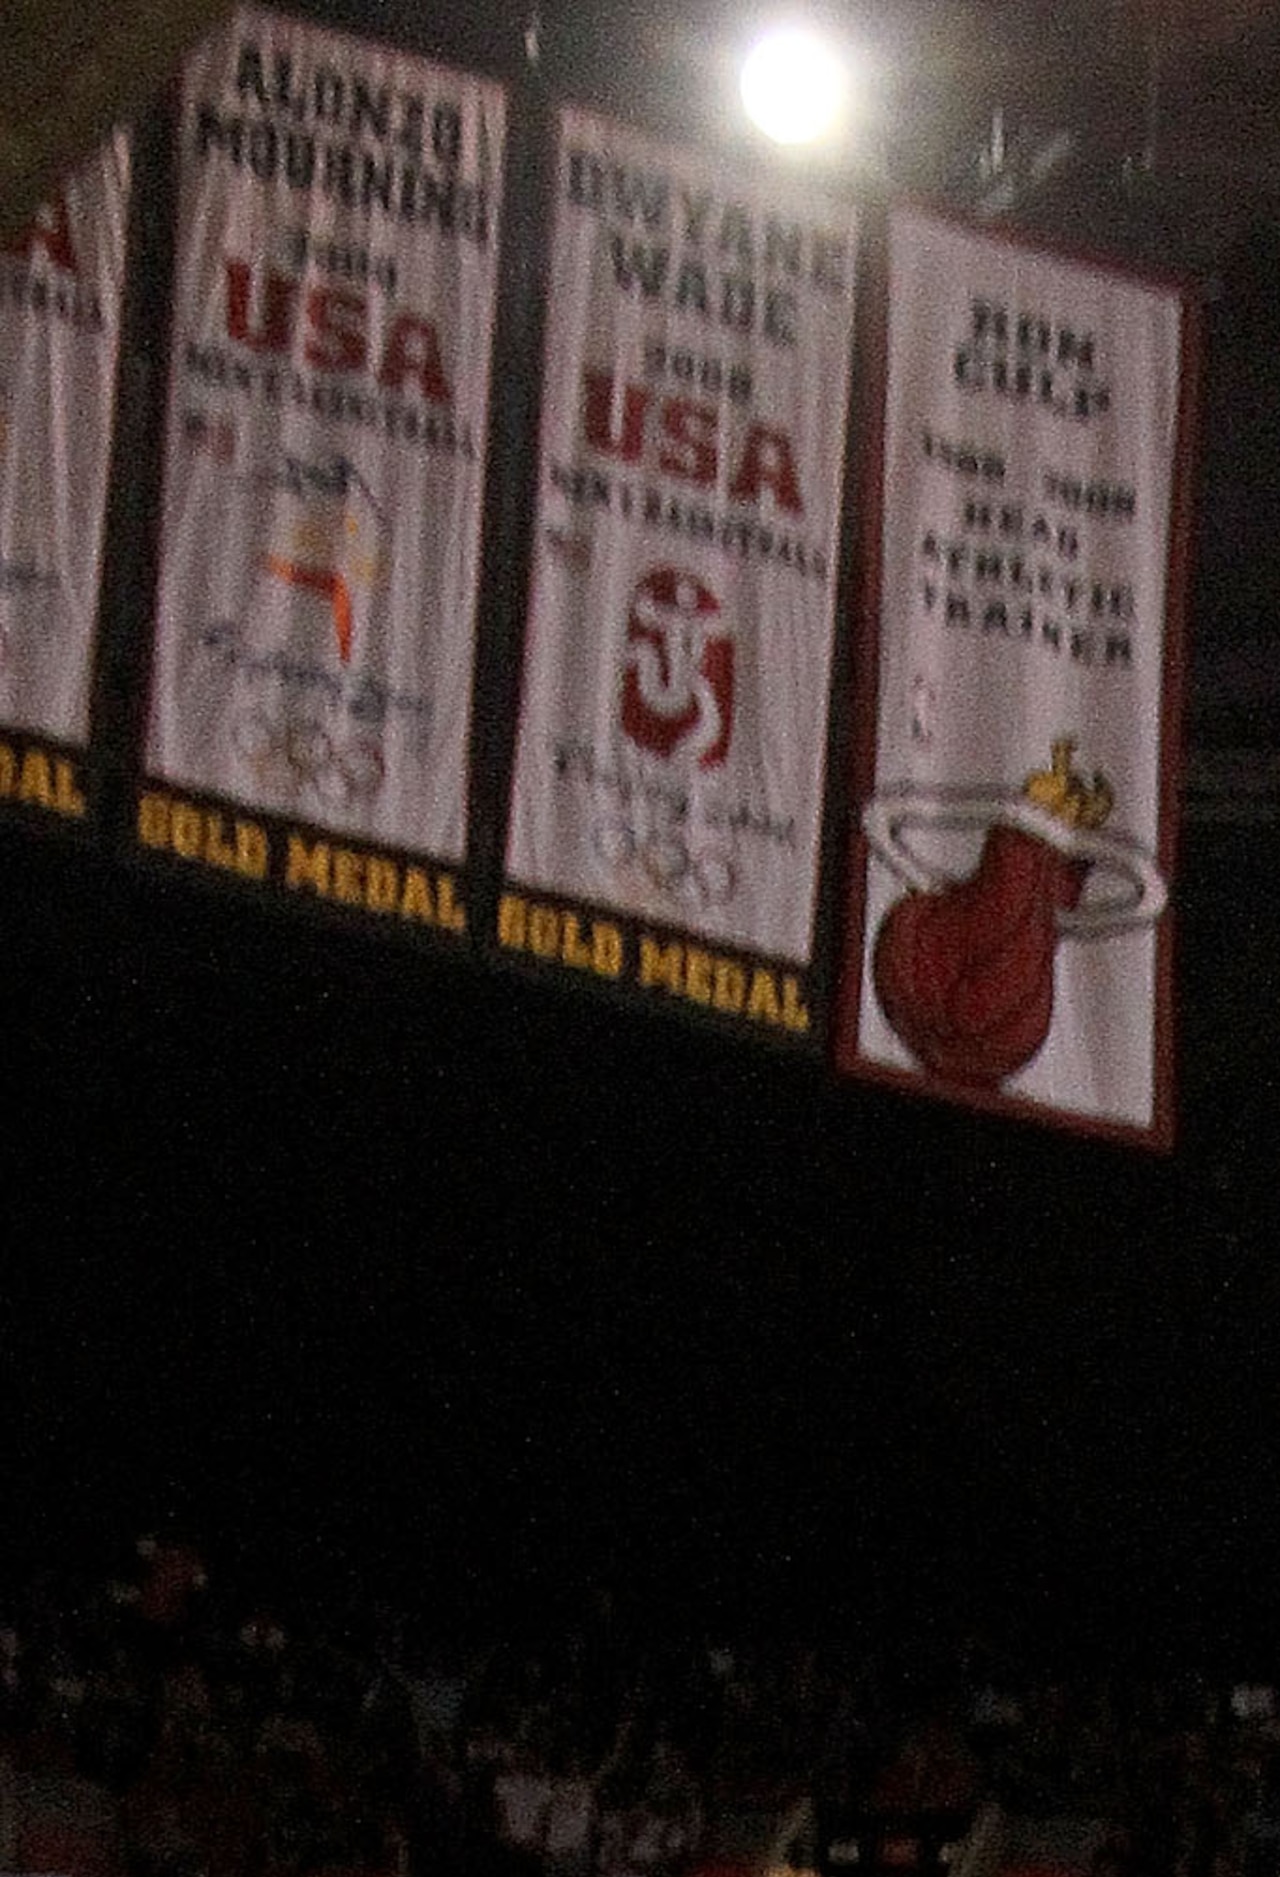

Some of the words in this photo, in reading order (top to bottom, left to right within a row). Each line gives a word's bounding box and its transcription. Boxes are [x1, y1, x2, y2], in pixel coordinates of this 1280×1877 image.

[225, 262, 453, 405] USA
[581, 364, 804, 519] USA
[137, 791, 269, 878] GOLD
[286, 834, 466, 936] MEDAL
[498, 896, 623, 978] GOLD
[640, 936, 809, 1032] MEDAL
